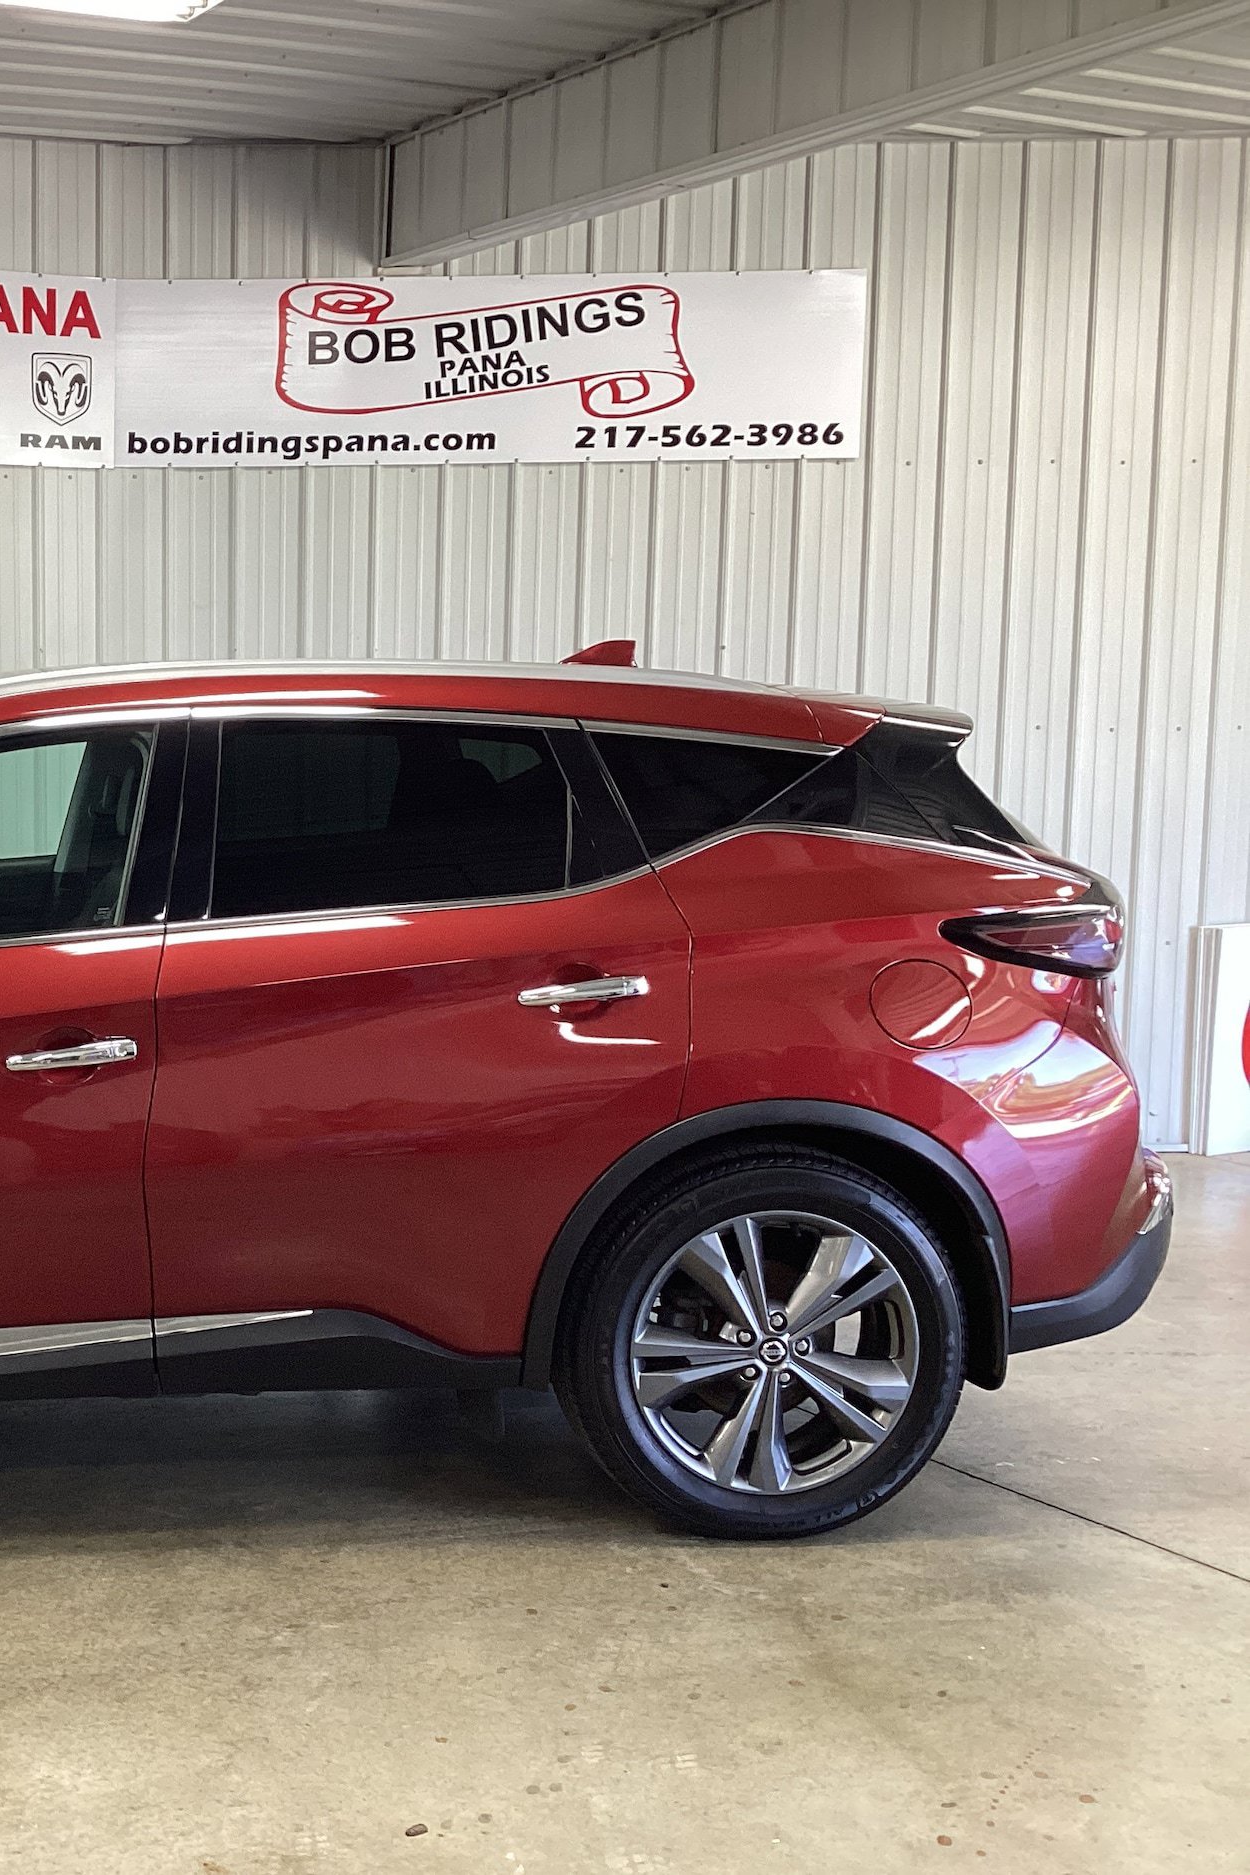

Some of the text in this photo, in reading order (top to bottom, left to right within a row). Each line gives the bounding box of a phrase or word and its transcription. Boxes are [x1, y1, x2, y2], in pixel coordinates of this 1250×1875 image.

[307, 291, 646, 366] BOB RIDINGS
[439, 350, 527, 379] PANA
[424, 364, 551, 400] ILLINOIS
[20, 433, 102, 451] RAM
[127, 431, 496, 460] bobridingspana.com
[575, 422, 844, 449] 217-562-3986
